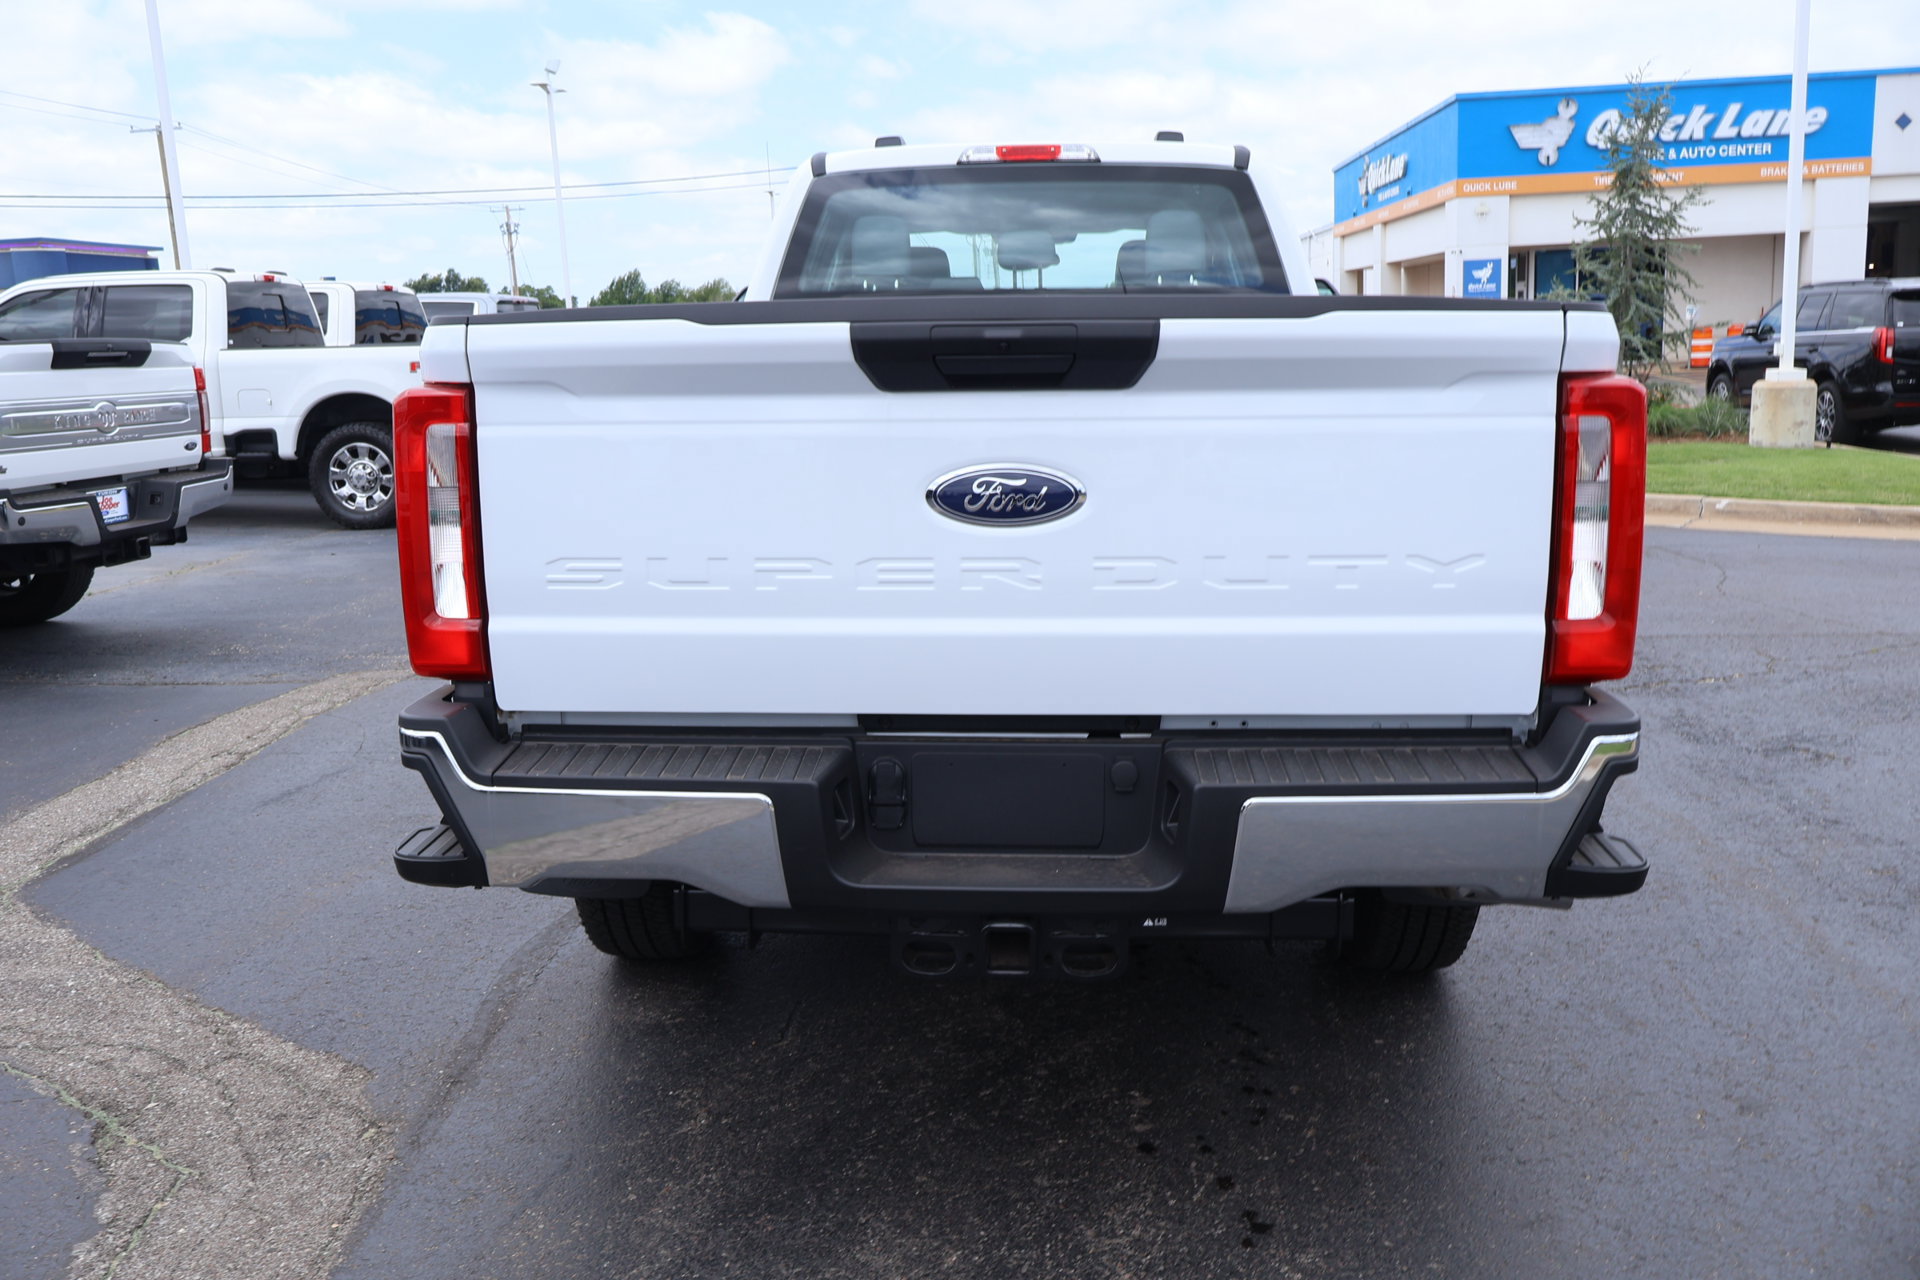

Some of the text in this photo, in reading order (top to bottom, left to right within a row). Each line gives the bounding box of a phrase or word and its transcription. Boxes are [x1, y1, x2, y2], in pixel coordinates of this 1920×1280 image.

[1713, 102, 1828, 140] Lane
[1668, 147, 1676, 160] &
[1679, 145, 1716, 159] AUTO
[1719, 143, 1772, 158] CENTER
[1811, 162, 1865, 175] BATTERIES
[1463, 182, 1491, 193] QUICK
[1493, 181, 1517, 191] LUBE
[963, 476, 1049, 513] Ford
[545, 554, 1487, 591] SUPER DUTY
